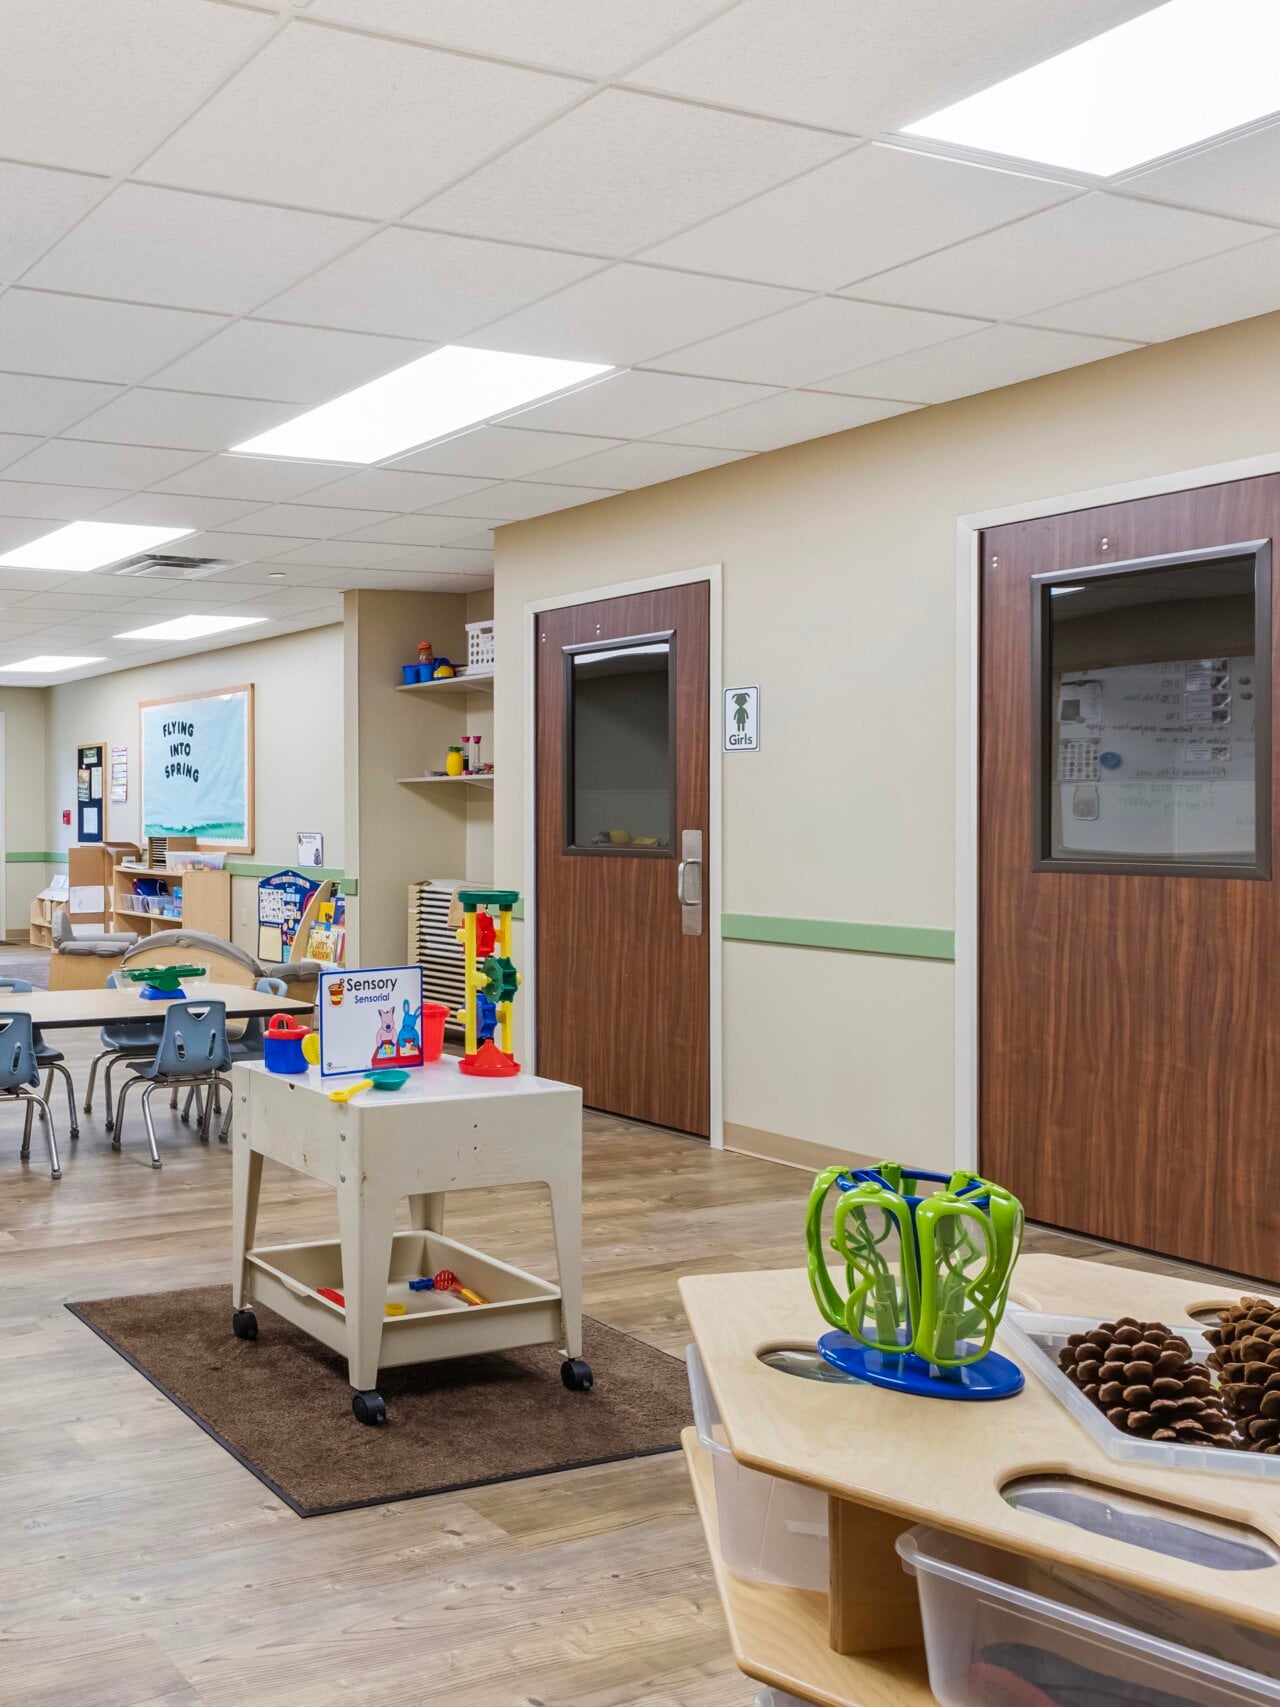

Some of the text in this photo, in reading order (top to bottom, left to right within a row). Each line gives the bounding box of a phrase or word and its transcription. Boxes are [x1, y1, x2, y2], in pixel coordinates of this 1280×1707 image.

[163, 721, 194, 737] FLYING
[729, 733, 753, 745] Girls
[170, 742, 191, 757] INTO
[165, 762, 199, 782] SPRING
[346, 978, 398, 992] Sensory
[354, 993, 390, 1004] Sensorial
